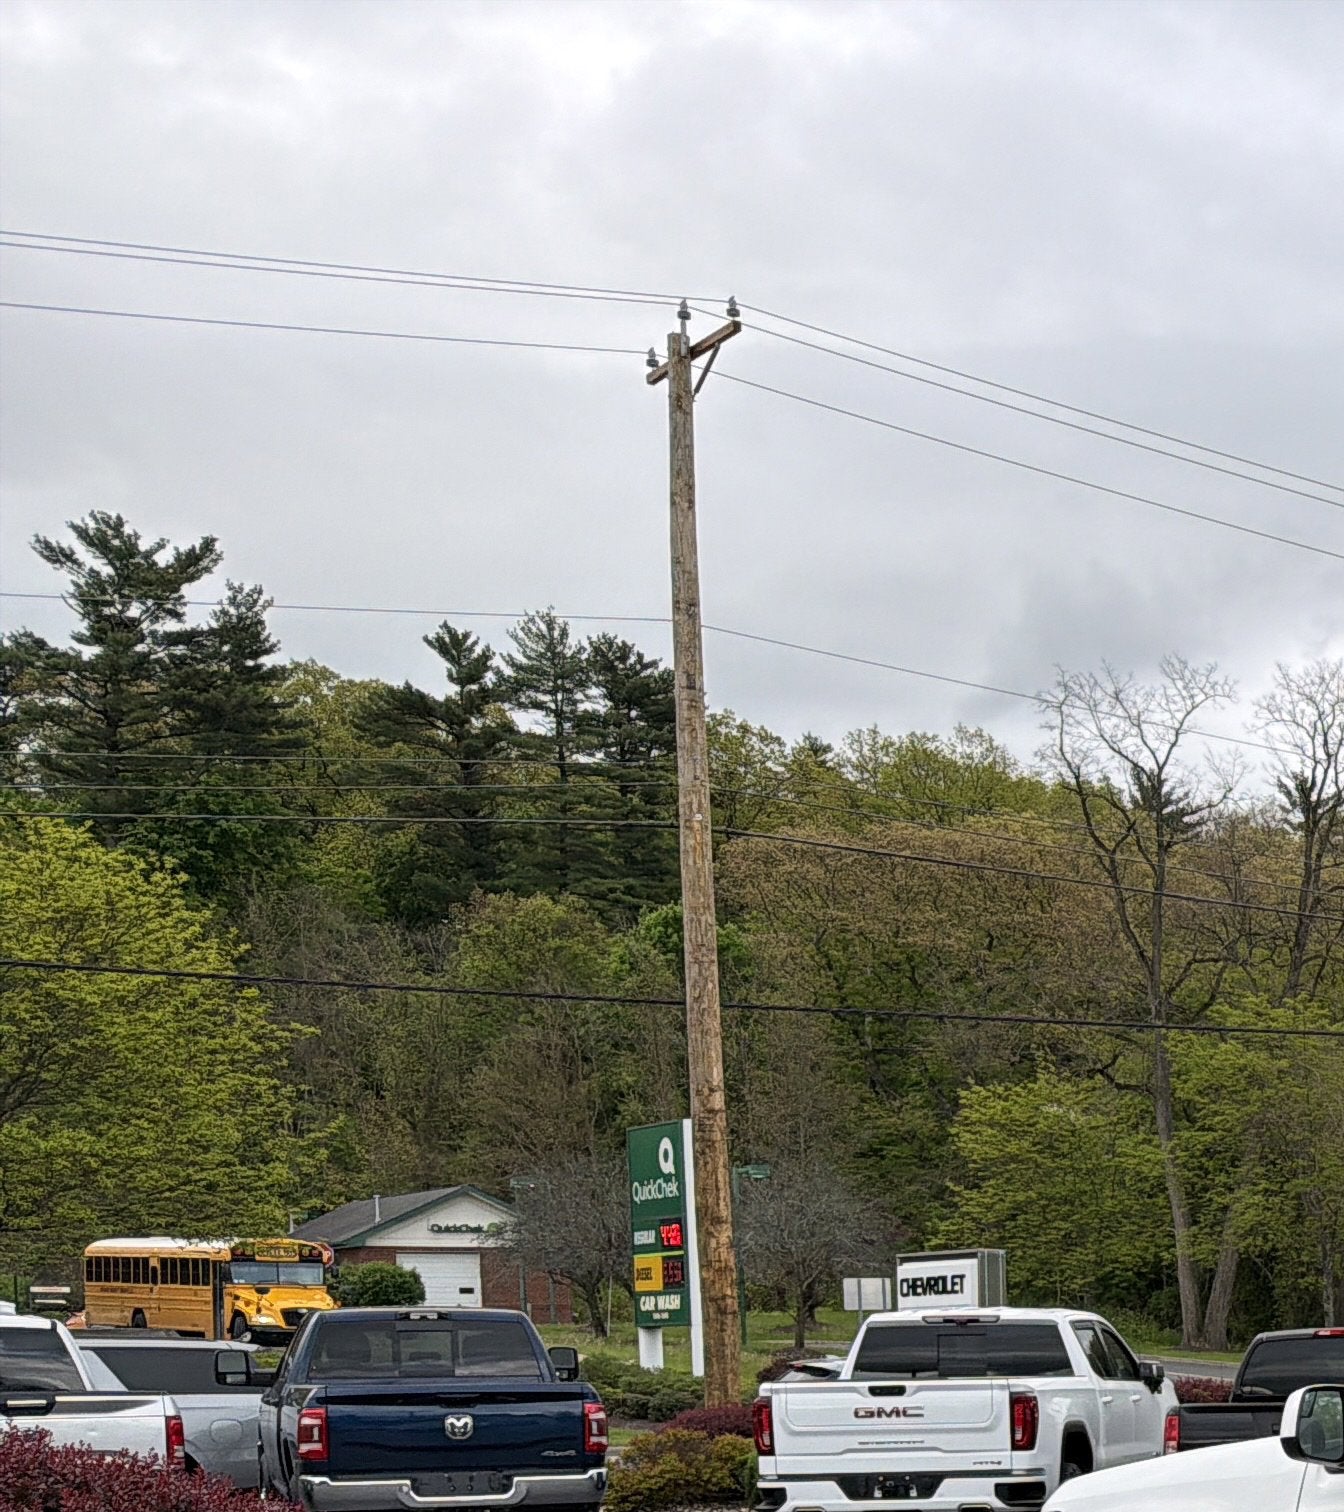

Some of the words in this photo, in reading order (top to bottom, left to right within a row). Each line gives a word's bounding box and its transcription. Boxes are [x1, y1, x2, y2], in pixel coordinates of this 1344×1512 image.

[658, 1137, 676, 1175] Q
[632, 1176, 679, 1204] QuickChek
[900, 1274, 966, 1297] CHEVROLET
[640, 1296, 656, 1311] CAR
[657, 1294, 681, 1311] WASH
[854, 1406, 925, 1418] GMC
